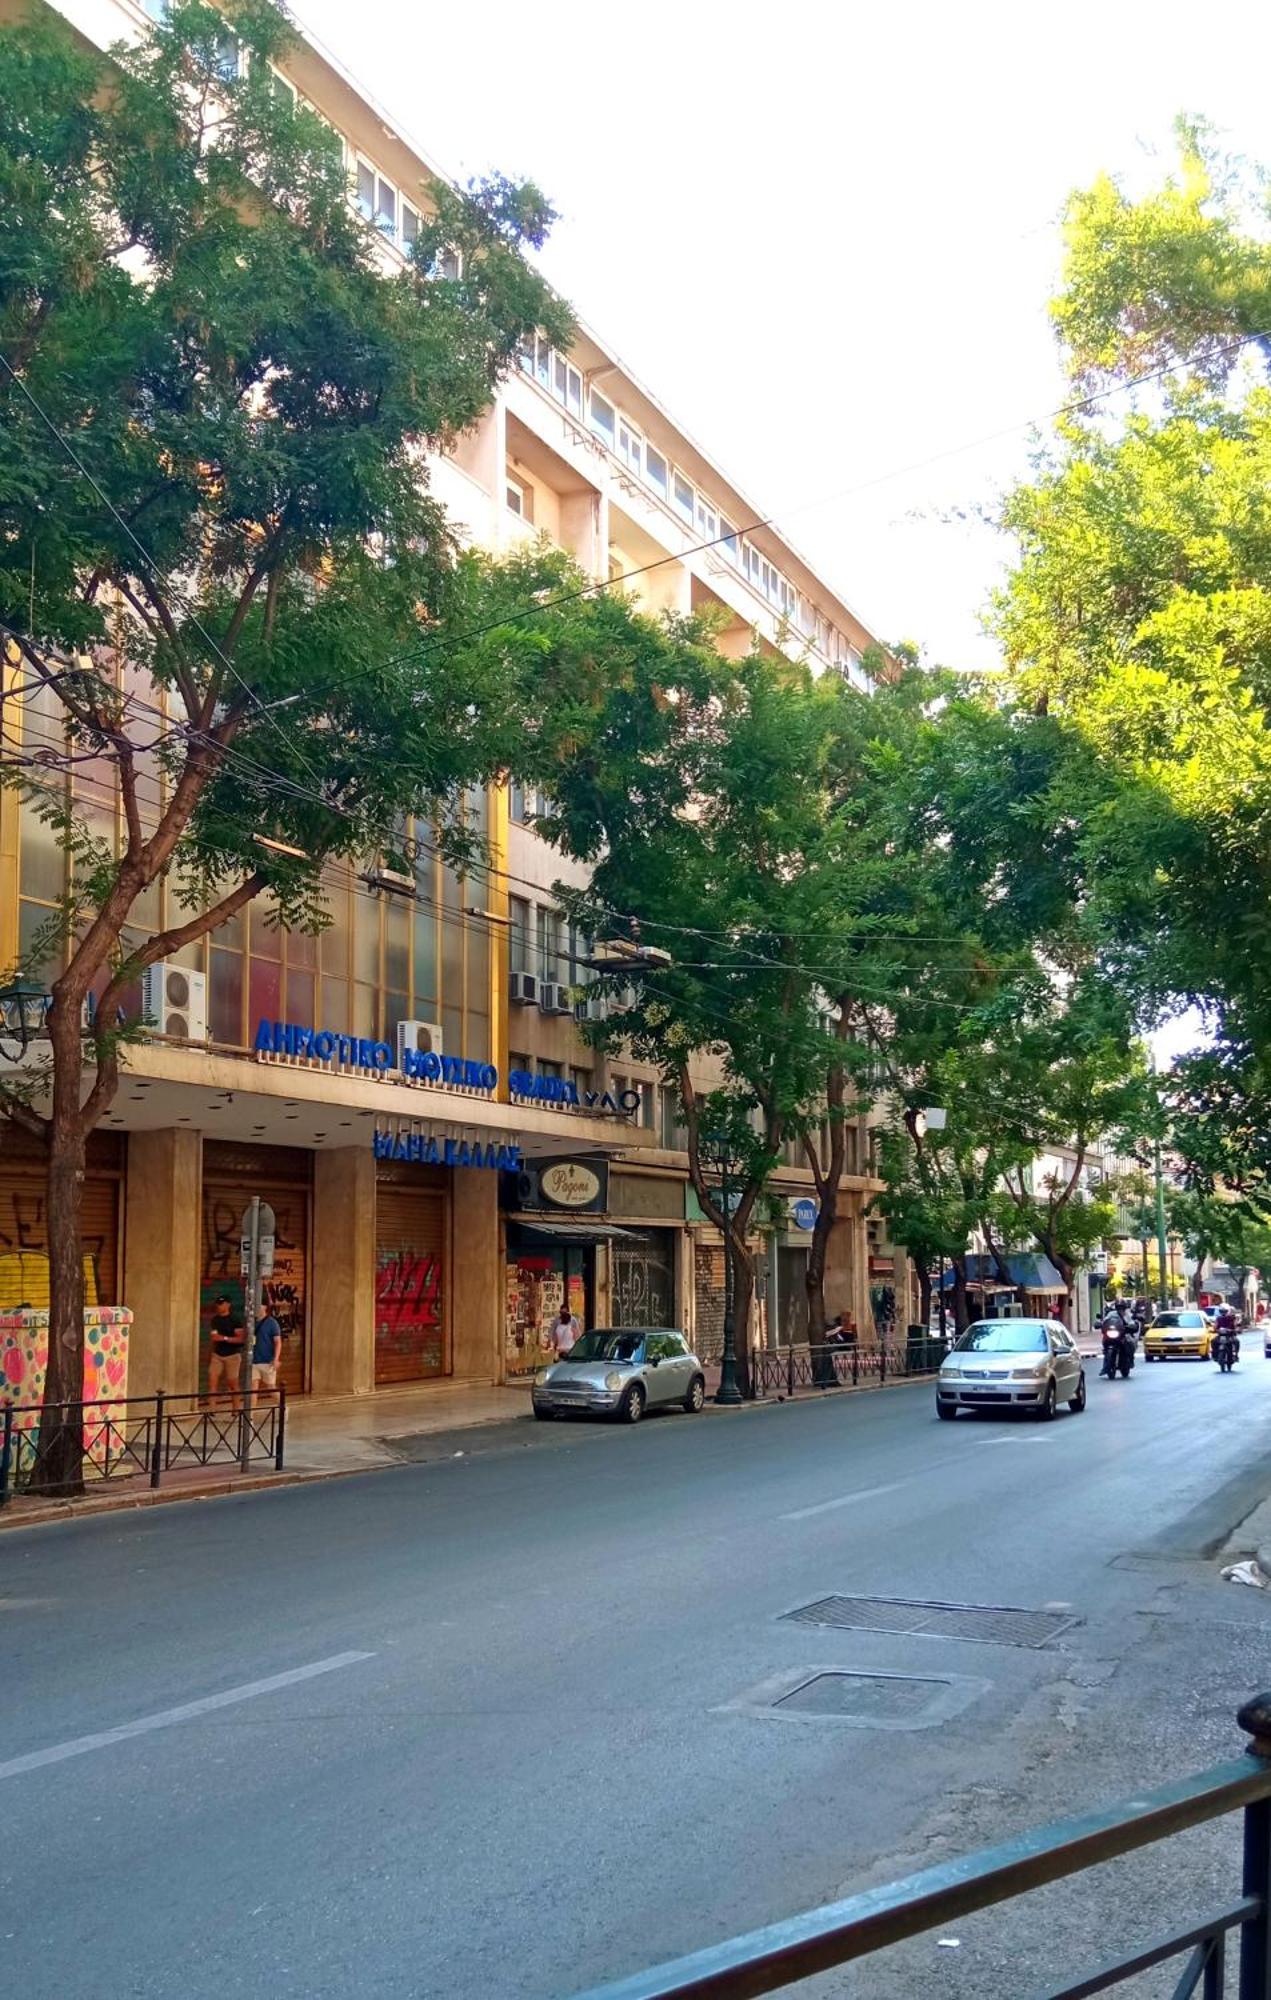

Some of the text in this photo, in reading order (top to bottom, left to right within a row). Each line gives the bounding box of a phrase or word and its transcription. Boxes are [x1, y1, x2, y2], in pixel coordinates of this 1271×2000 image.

[255, 1018, 393, 1070] ΔΗΜΟΤΙΚΟ
[404, 1047, 498, 1089] ΜΟΥΣΙΚΟ
[444, 1138, 521, 1173] ΚΑΛΛΑΣ
